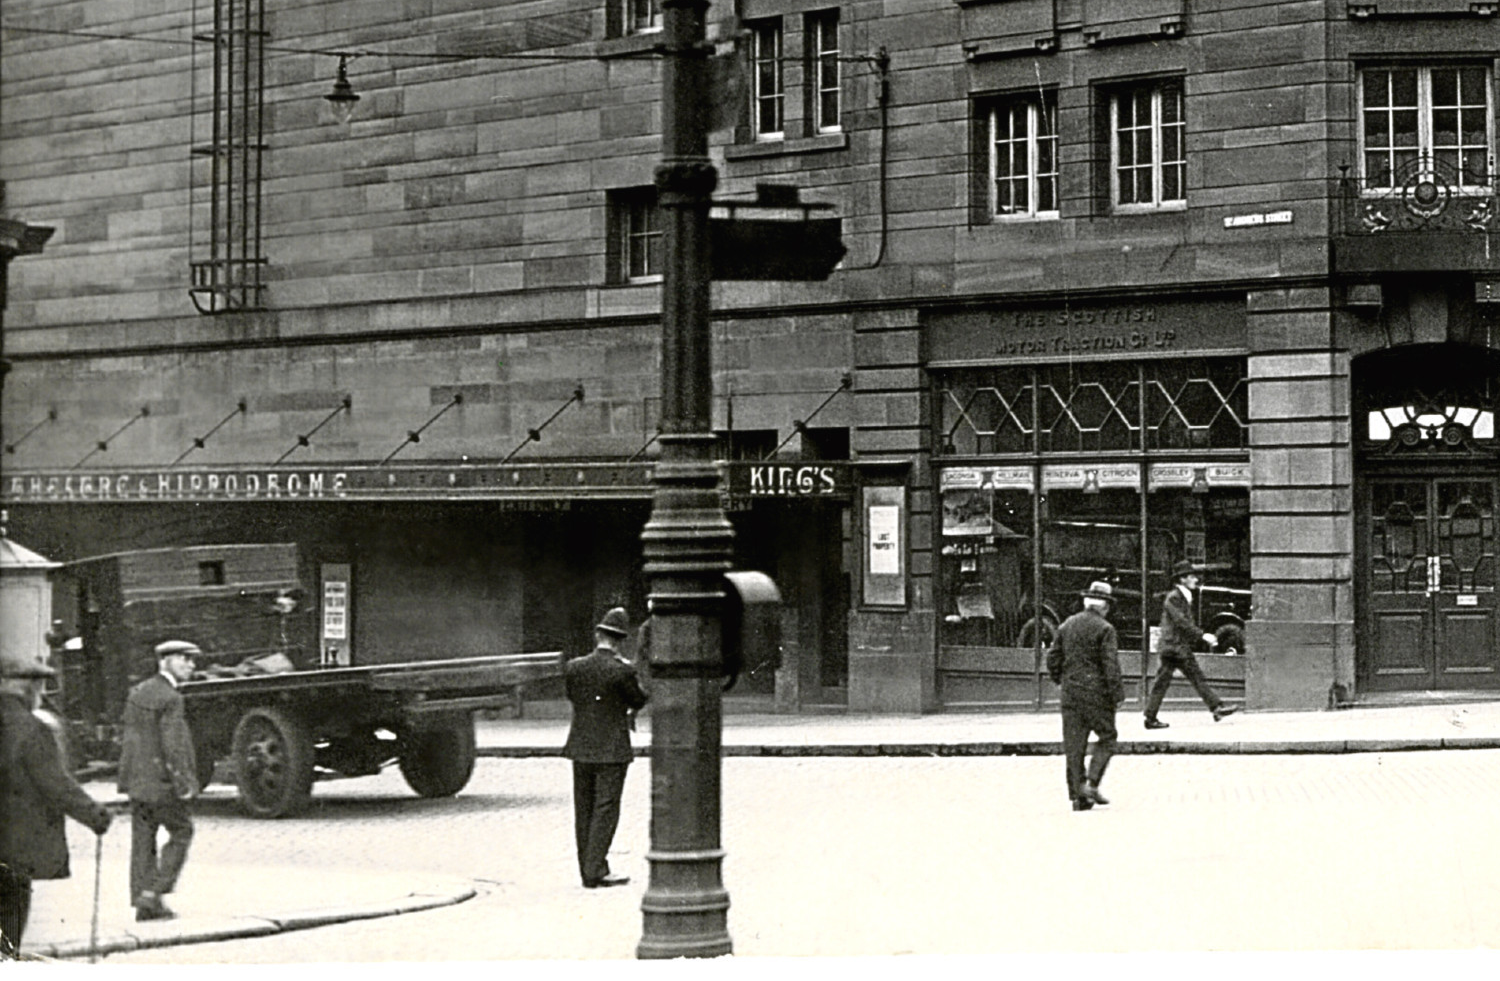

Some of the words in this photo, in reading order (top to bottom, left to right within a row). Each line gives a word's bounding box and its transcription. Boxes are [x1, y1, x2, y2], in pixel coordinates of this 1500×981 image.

[751, 467, 836, 495] KING'S
[1215, 468, 1244, 476] BUICK
[158, 473, 347, 498] HIPPODROME
